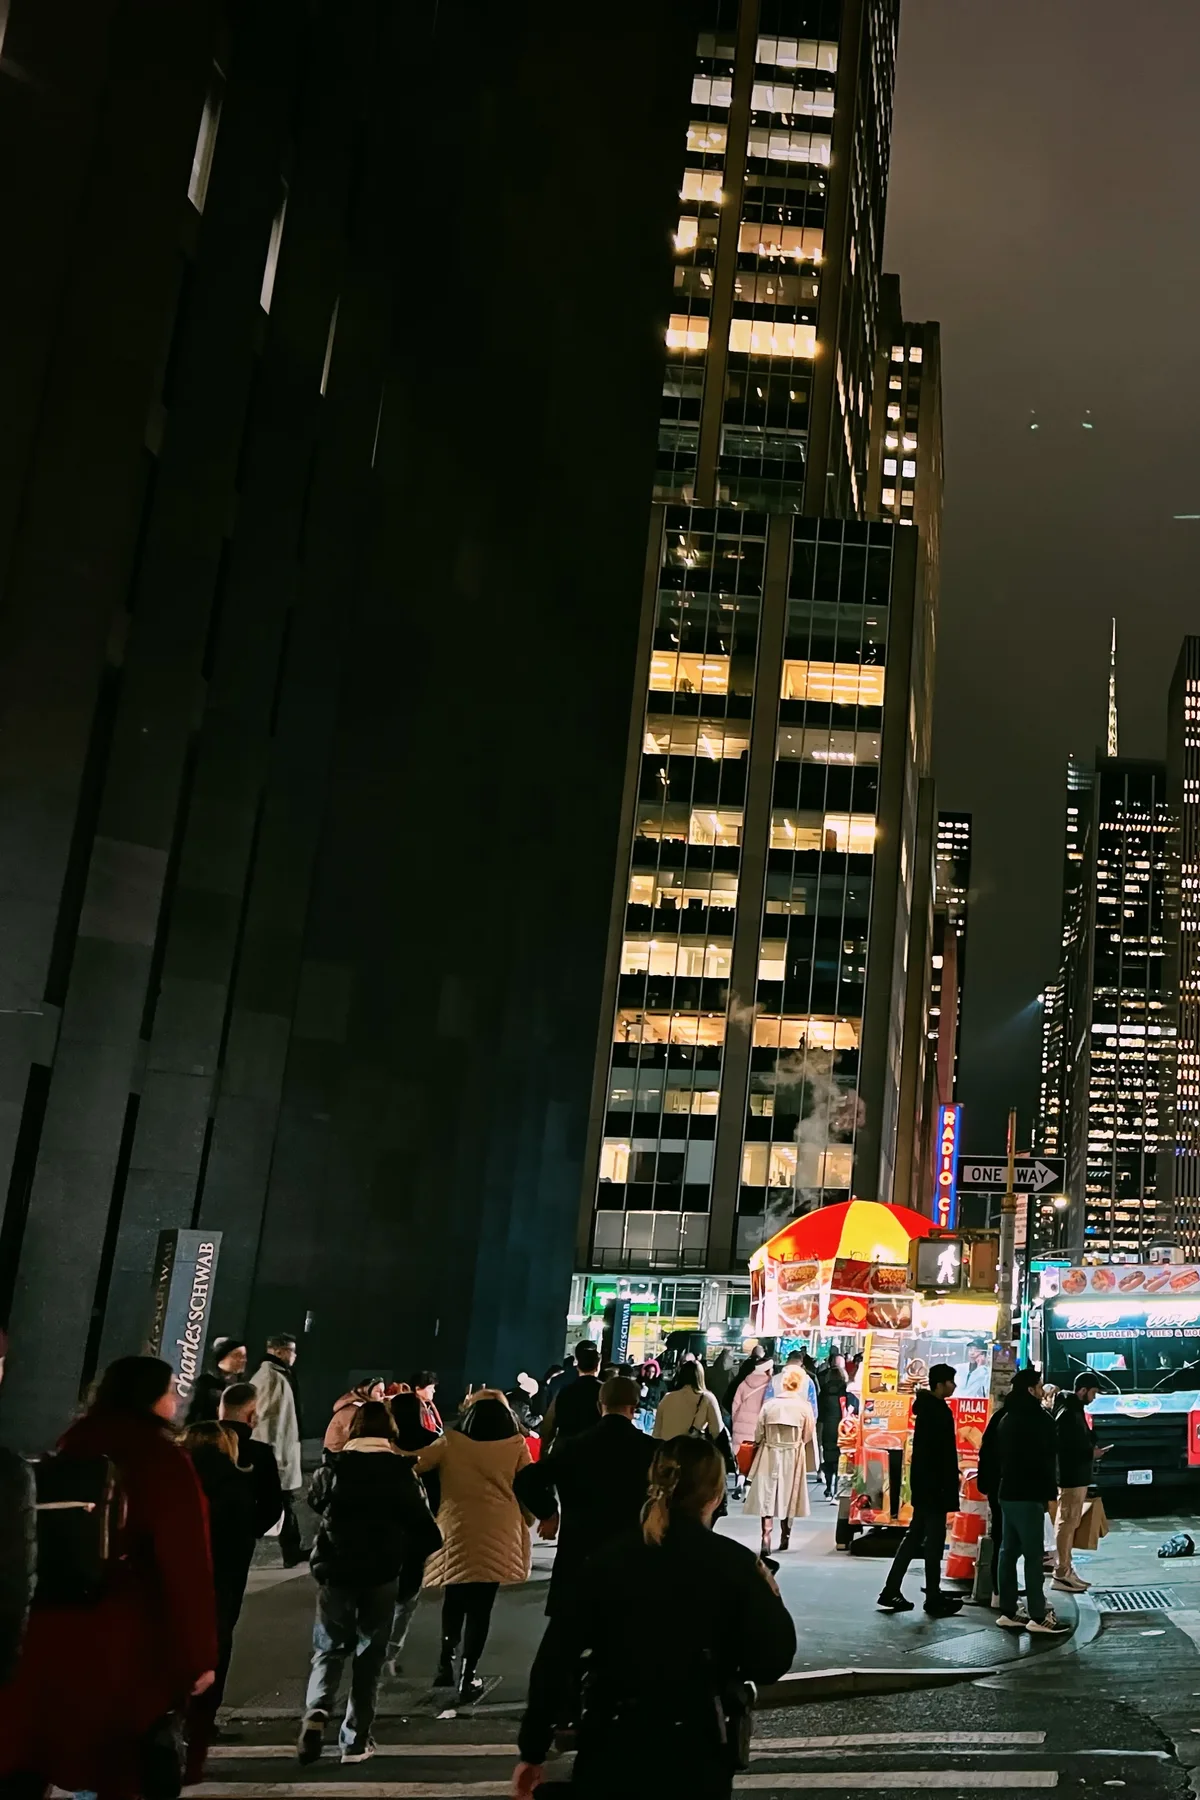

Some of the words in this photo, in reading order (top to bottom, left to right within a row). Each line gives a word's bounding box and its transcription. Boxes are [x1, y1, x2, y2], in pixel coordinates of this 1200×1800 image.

[938, 1111, 956, 1186] RADIO
[971, 1167, 1003, 1182] ONE
[1016, 1168, 1049, 1183] WAY
[937, 1197, 951, 1227] CI
[188, 1241, 215, 1321] SCHWAB
[1057, 1331, 1086, 1339] WINGS
[1096, 1330, 1138, 1339] BURGERS
[874, 1400, 904, 1409] COFFEE
[959, 1400, 986, 1413] HALAL
